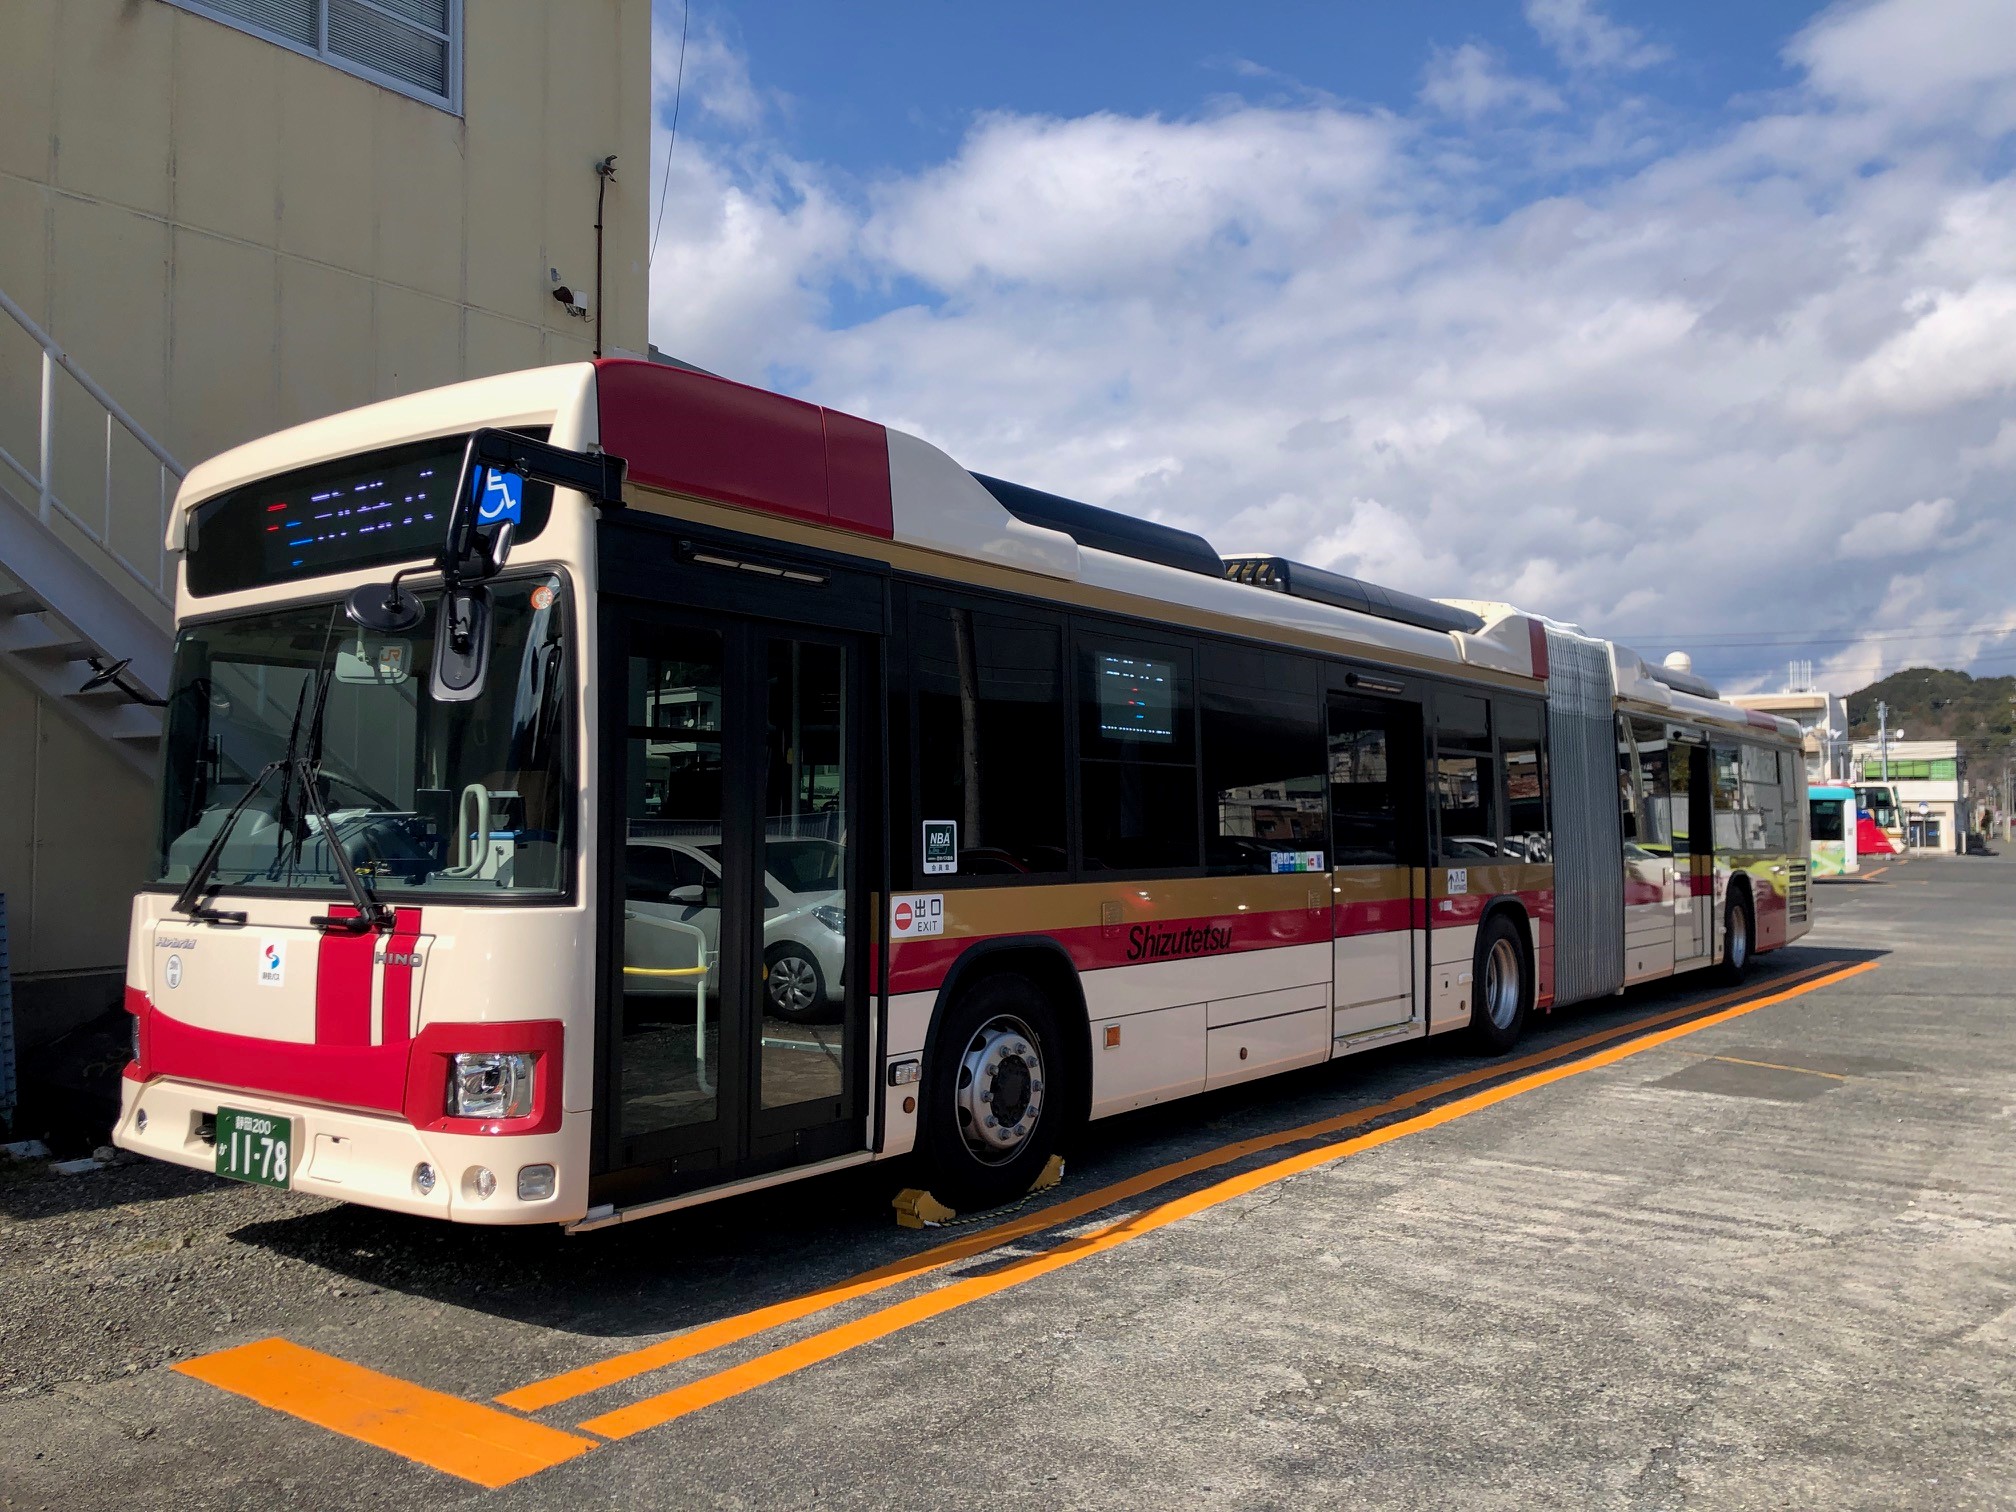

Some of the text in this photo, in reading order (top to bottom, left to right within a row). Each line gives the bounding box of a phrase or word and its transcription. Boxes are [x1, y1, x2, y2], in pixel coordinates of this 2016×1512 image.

[930, 832, 950, 844] NBA
[914, 898, 941, 918] 出口
[917, 920, 938, 932] EXIT
[155, 936, 198, 950] Hybrid
[1126, 924, 1232, 960] Shizutetsu
[374, 951, 423, 968] HINO
